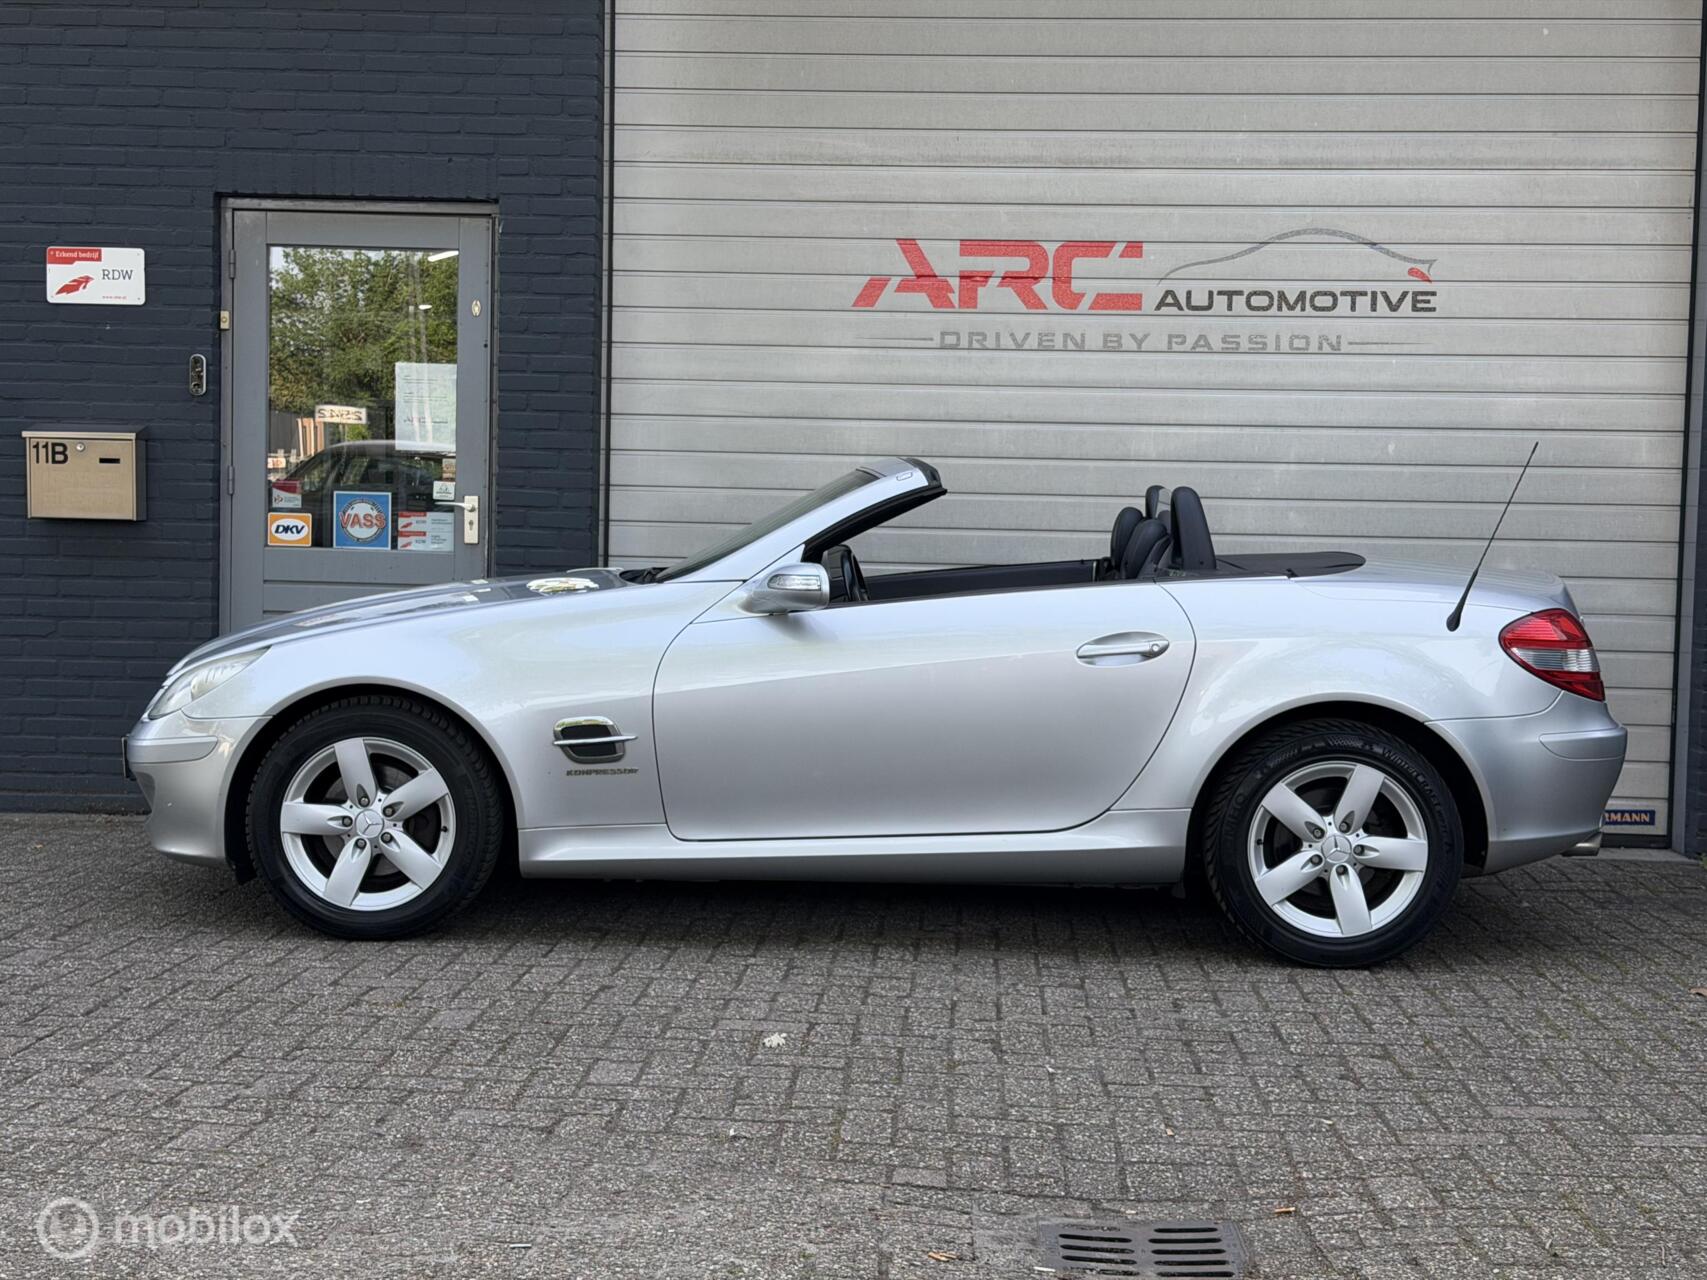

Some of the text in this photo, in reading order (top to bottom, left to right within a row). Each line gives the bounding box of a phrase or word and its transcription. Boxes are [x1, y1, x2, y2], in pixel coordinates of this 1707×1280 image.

[101, 268, 133, 281] RDW
[852, 239, 1437, 313] ARC AUTOMOTIVE
[939, 331, 1343, 353] DRIVEN BY PASSION
[31, 441, 69, 465] 11B
[338, 512, 386, 529] VASS
[274, 524, 306, 535] DKV
[566, 768, 639, 776] KOMPRESSOR
